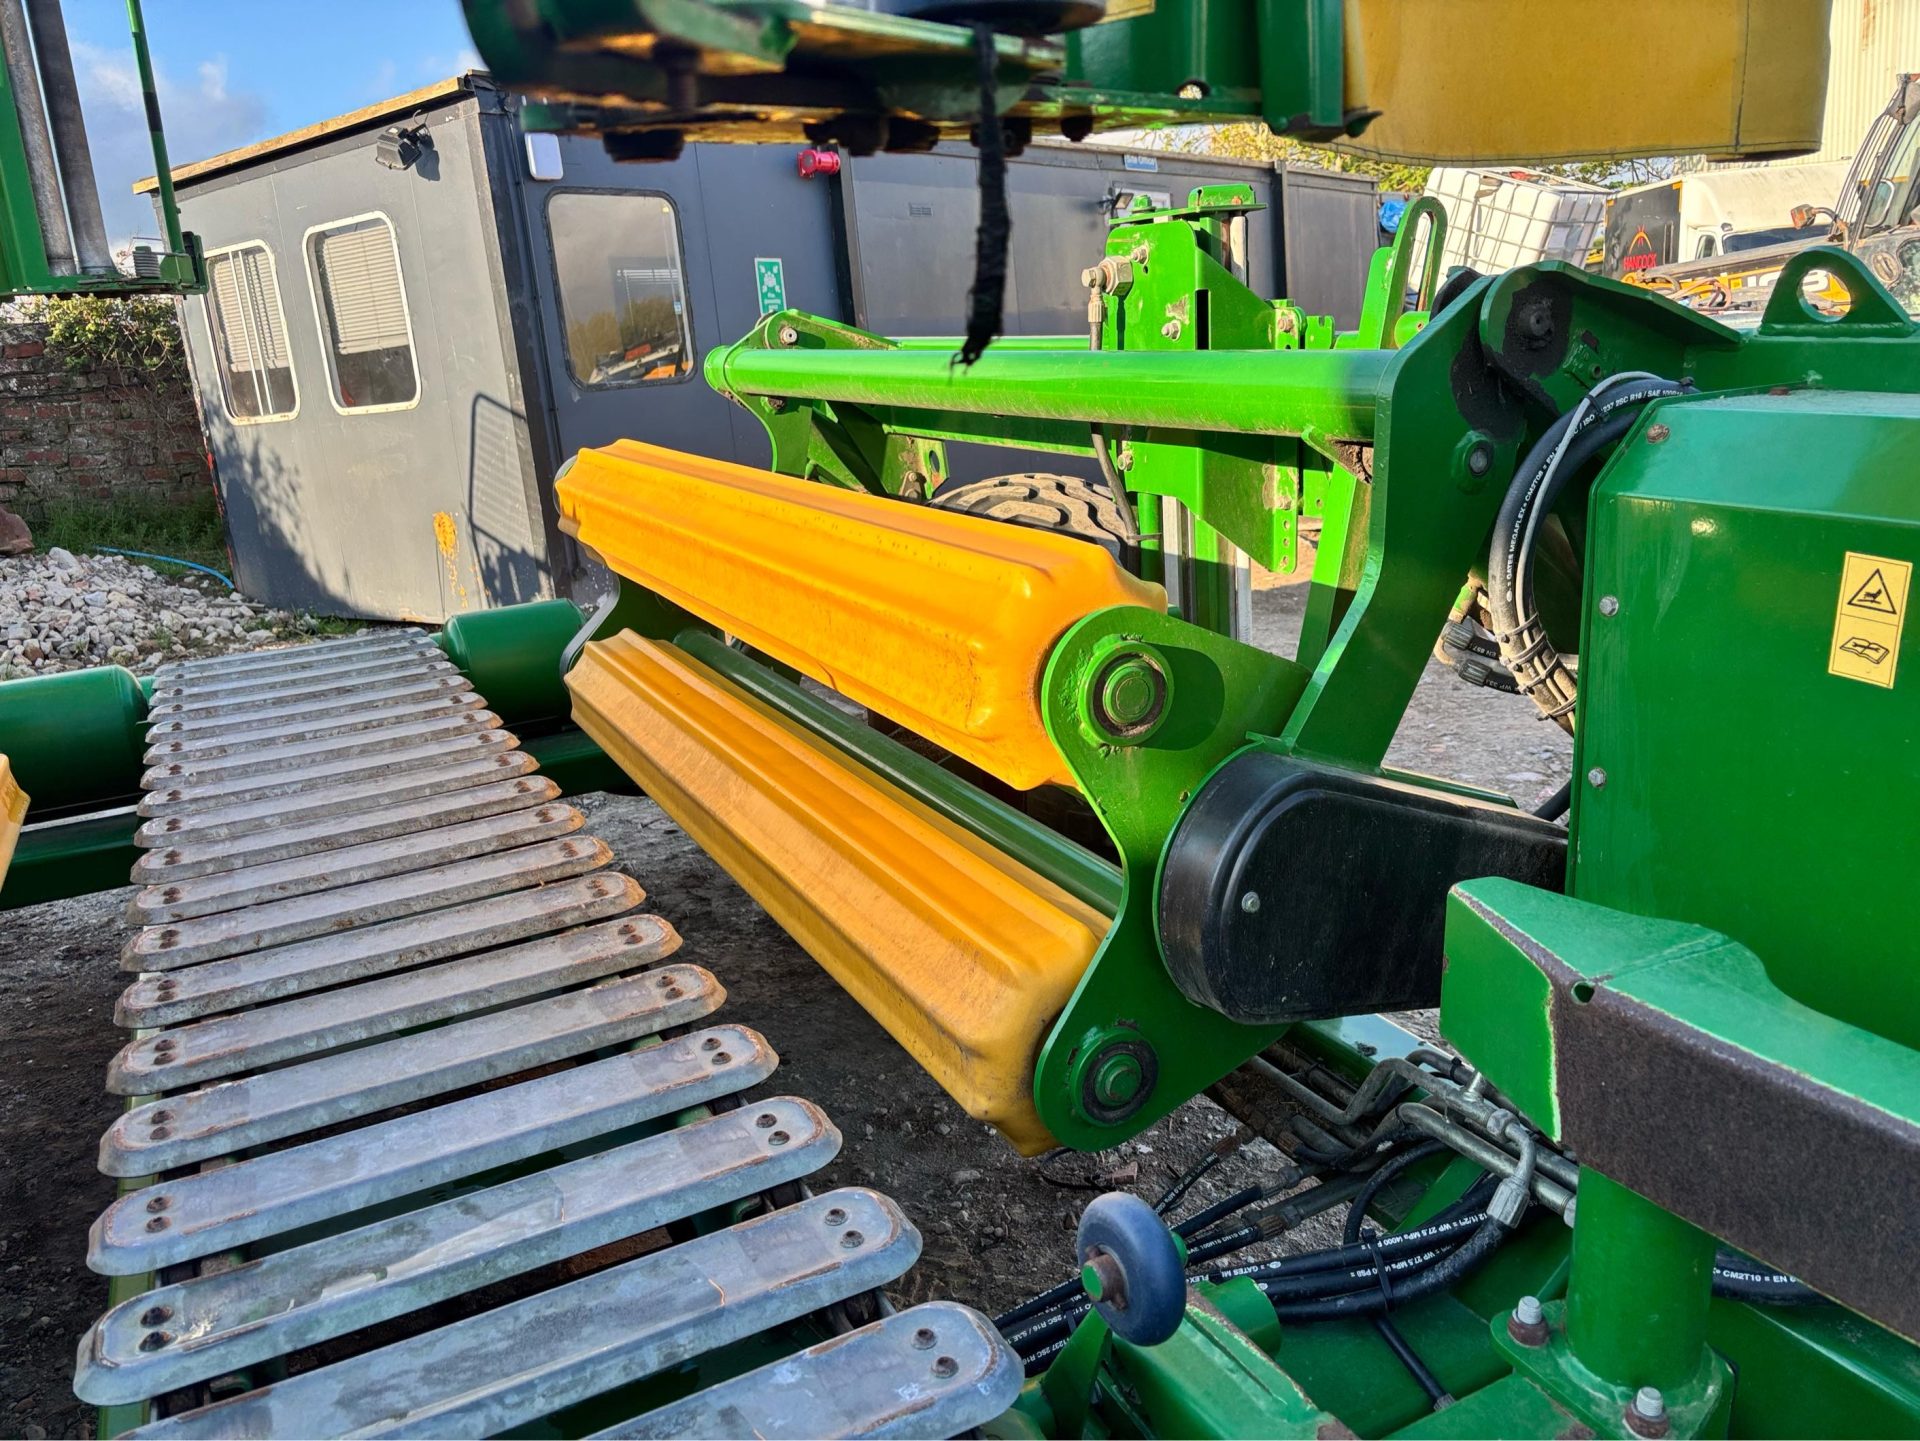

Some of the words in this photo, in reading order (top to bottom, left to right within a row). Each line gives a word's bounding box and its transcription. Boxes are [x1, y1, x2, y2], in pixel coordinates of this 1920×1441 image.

[1623, 253, 1657, 269] HANCOCK
[1506, 554, 1514, 579] GATES
[1583, 414, 1595, 426] ISO
[1615, 396, 1629, 407] 2SC
[1647, 390, 1660, 398] SAE
[1421, 1227, 1438, 1238] 27.5
[1438, 1223, 1452, 1233] WP
[1404, 1230, 1421, 1241] MPa
[1408, 1255, 1423, 1266] 27.5
[1423, 1251, 1436, 1262] WP
[1233, 1265, 1259, 1276] GATES
[1722, 1269, 1762, 1282] CM2T10
[1773, 1275, 1788, 1283] EN
[1048, 1315, 1062, 1325] 2SC
[1033, 1321, 1047, 1332] R16
[1053, 1337, 1070, 1350] 1237
[1037, 1346, 1051, 1359] 2SC
